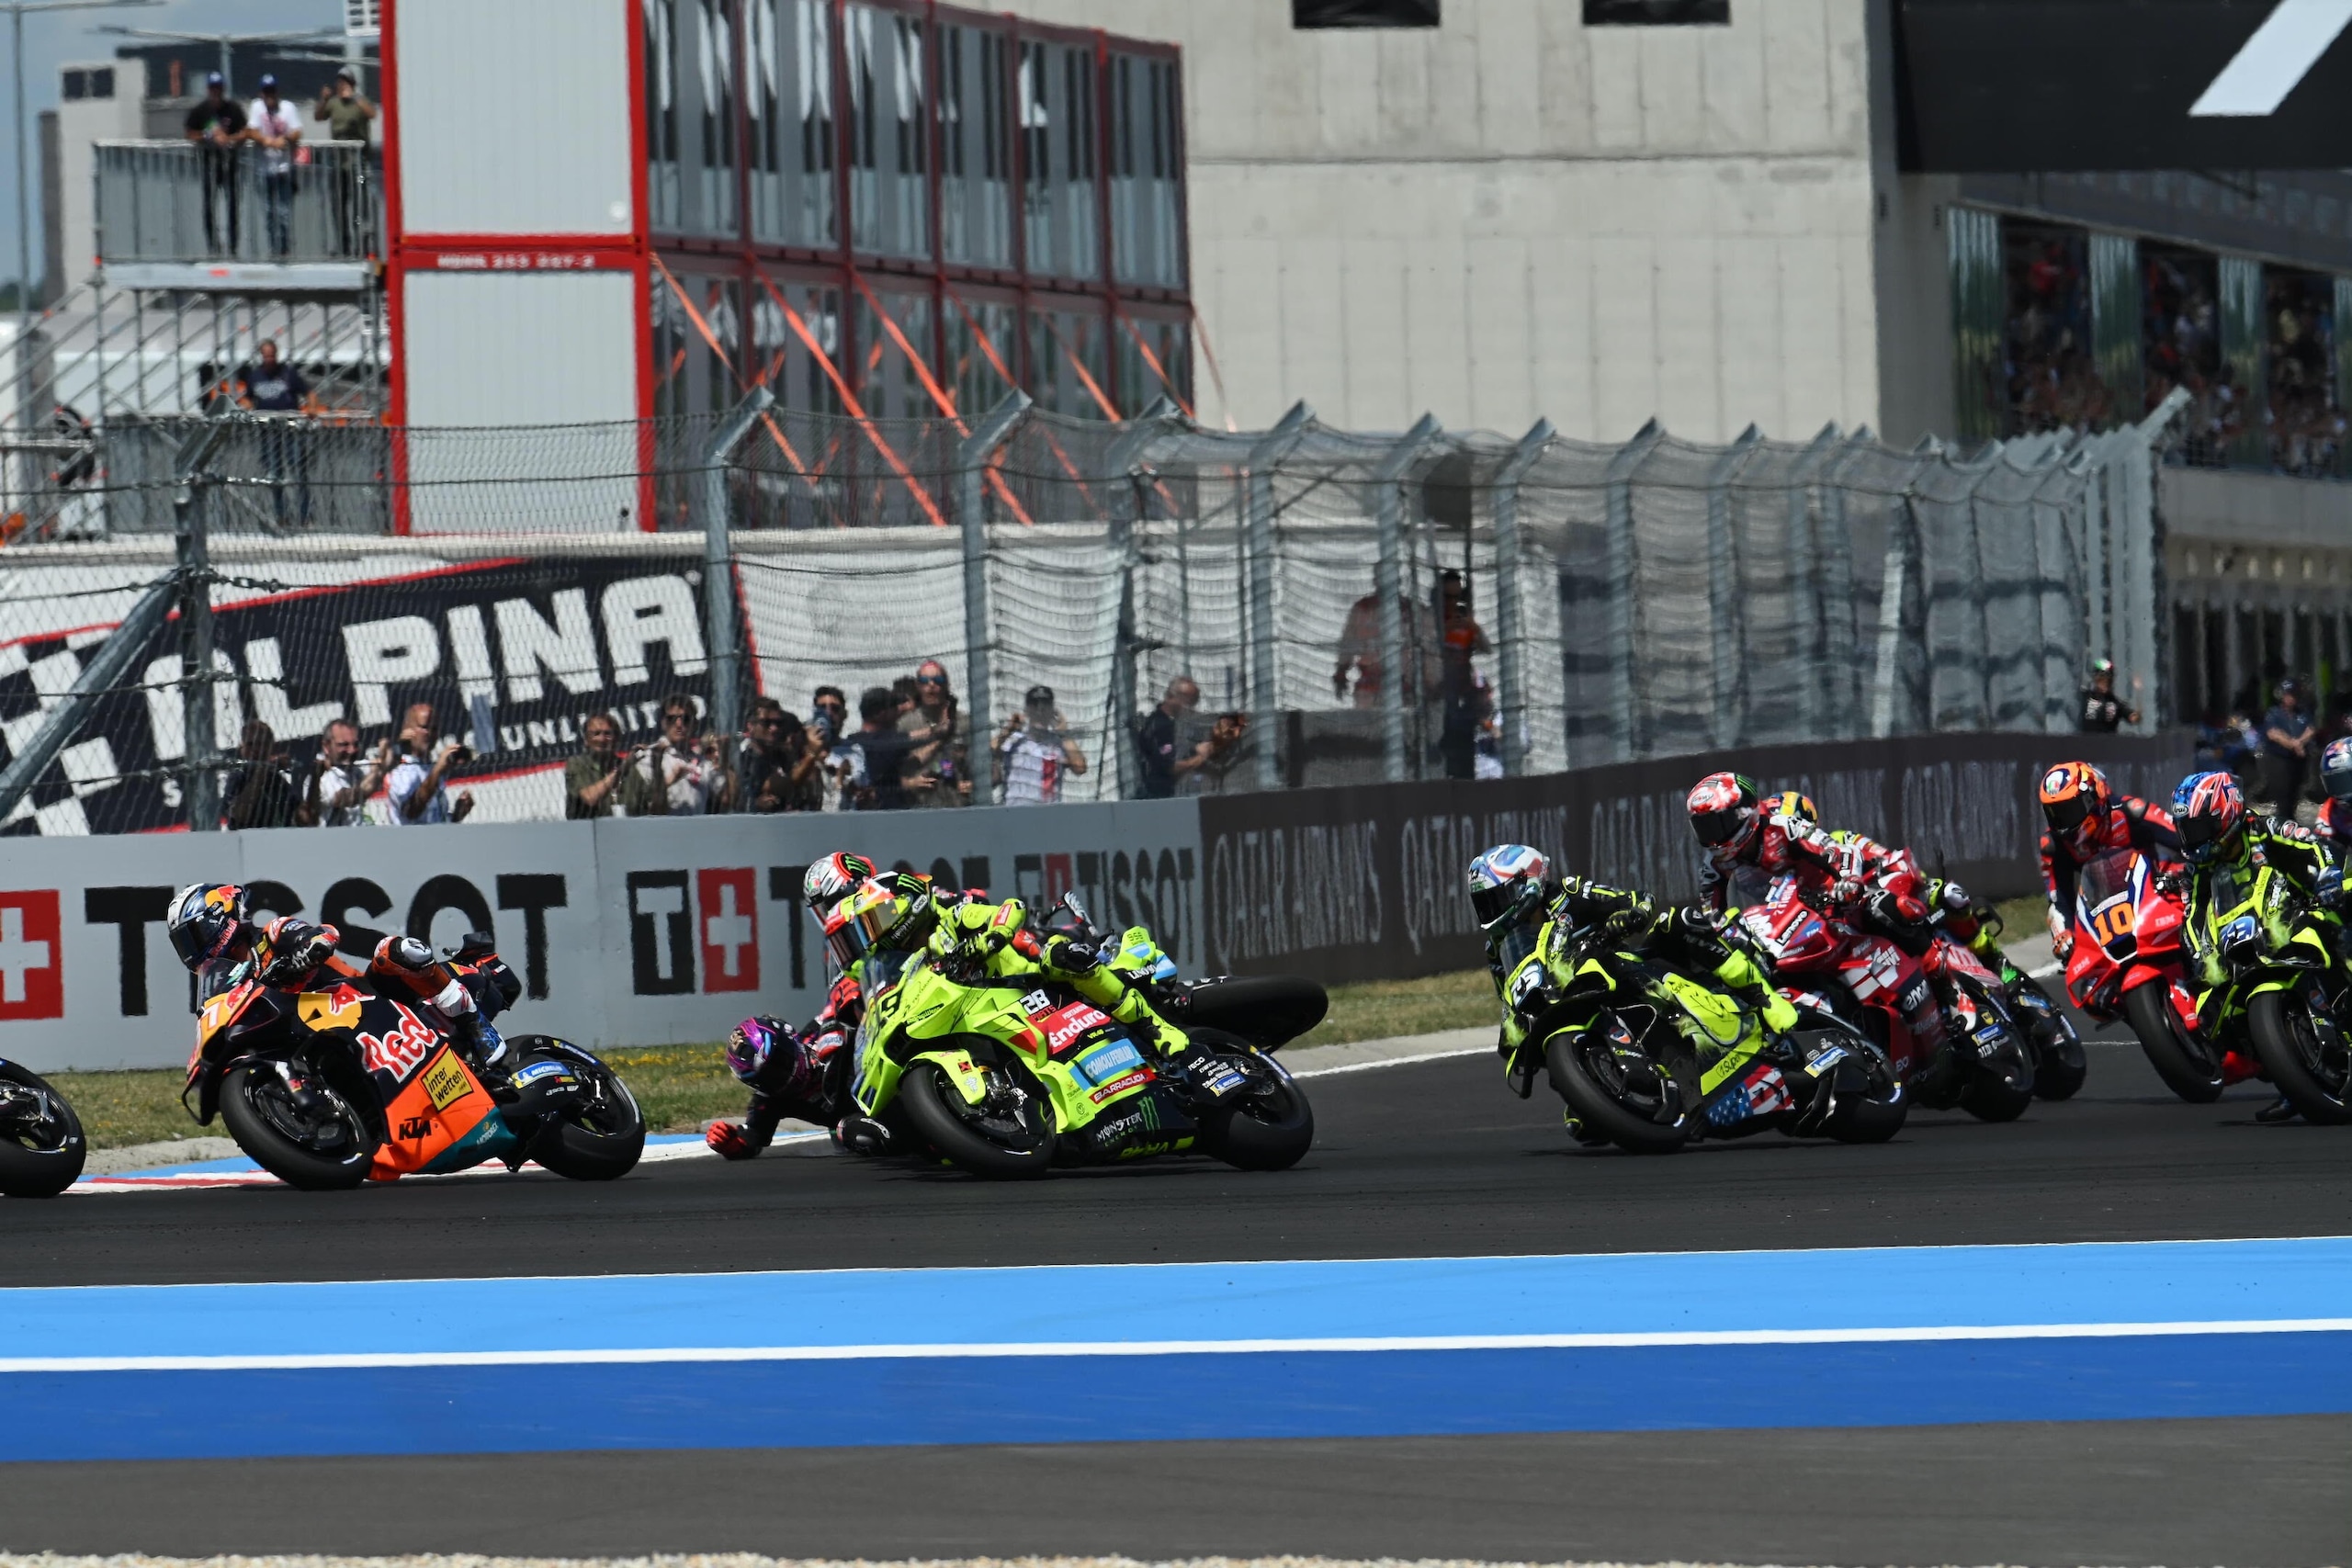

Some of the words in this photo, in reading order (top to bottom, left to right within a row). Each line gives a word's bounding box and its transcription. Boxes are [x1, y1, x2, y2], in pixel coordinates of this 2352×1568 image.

[1212, 829, 1288, 974] QATAR
[1778, 910, 1808, 944] Lenovo
[2093, 901, 2136, 947] 10
[355, 998, 439, 1085] Red
[426, 1066, 448, 1094] inter
[435, 1069, 465, 1103] wetten
[1093, 1073, 1147, 1102] BARRACUDA
[399, 1116, 432, 1141] KTM
[1096, 1111, 1143, 1143] MONSTER
